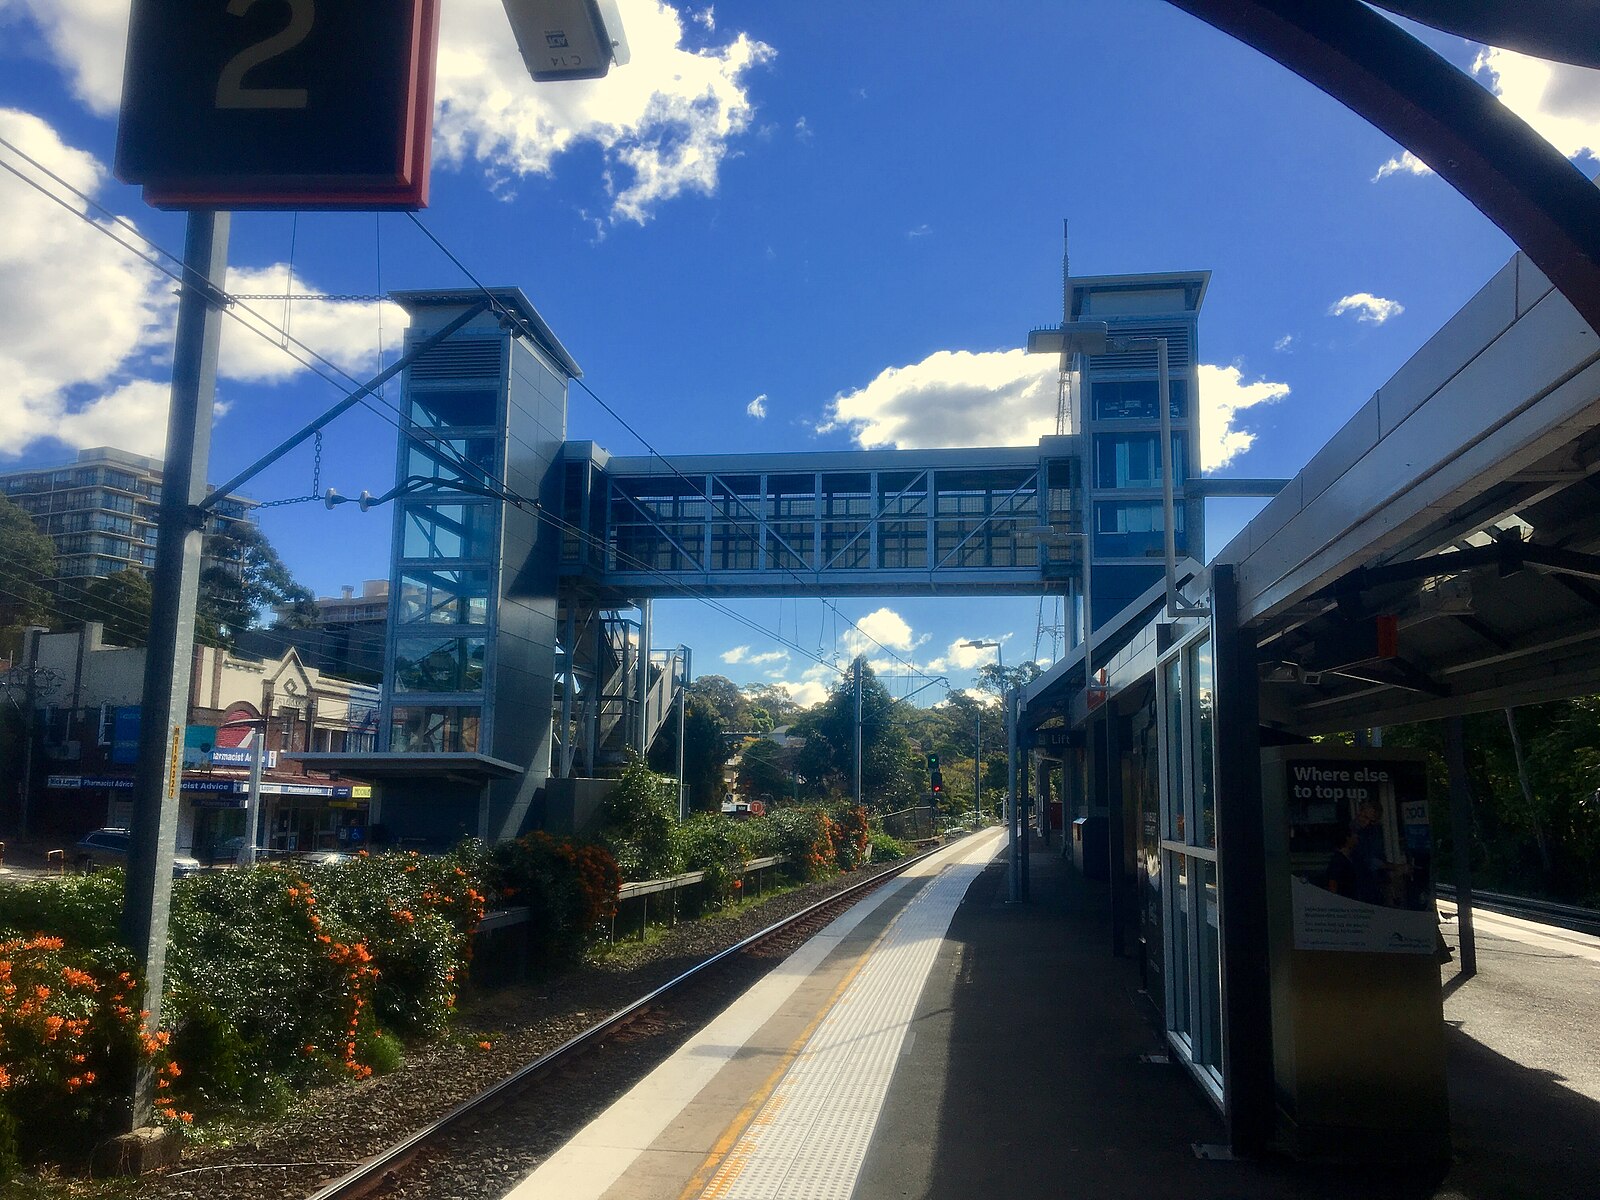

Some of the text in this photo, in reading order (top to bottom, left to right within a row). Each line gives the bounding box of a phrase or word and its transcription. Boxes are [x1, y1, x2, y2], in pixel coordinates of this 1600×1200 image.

[215, 0, 316, 109] 2
[1051, 734, 1071, 745] Lift
[1293, 766, 1389, 782] Where else
[83, 779, 134, 788] Pharmacist Advice
[200, 782, 229, 790] Advice
[1294, 785, 1368, 802] to top up
